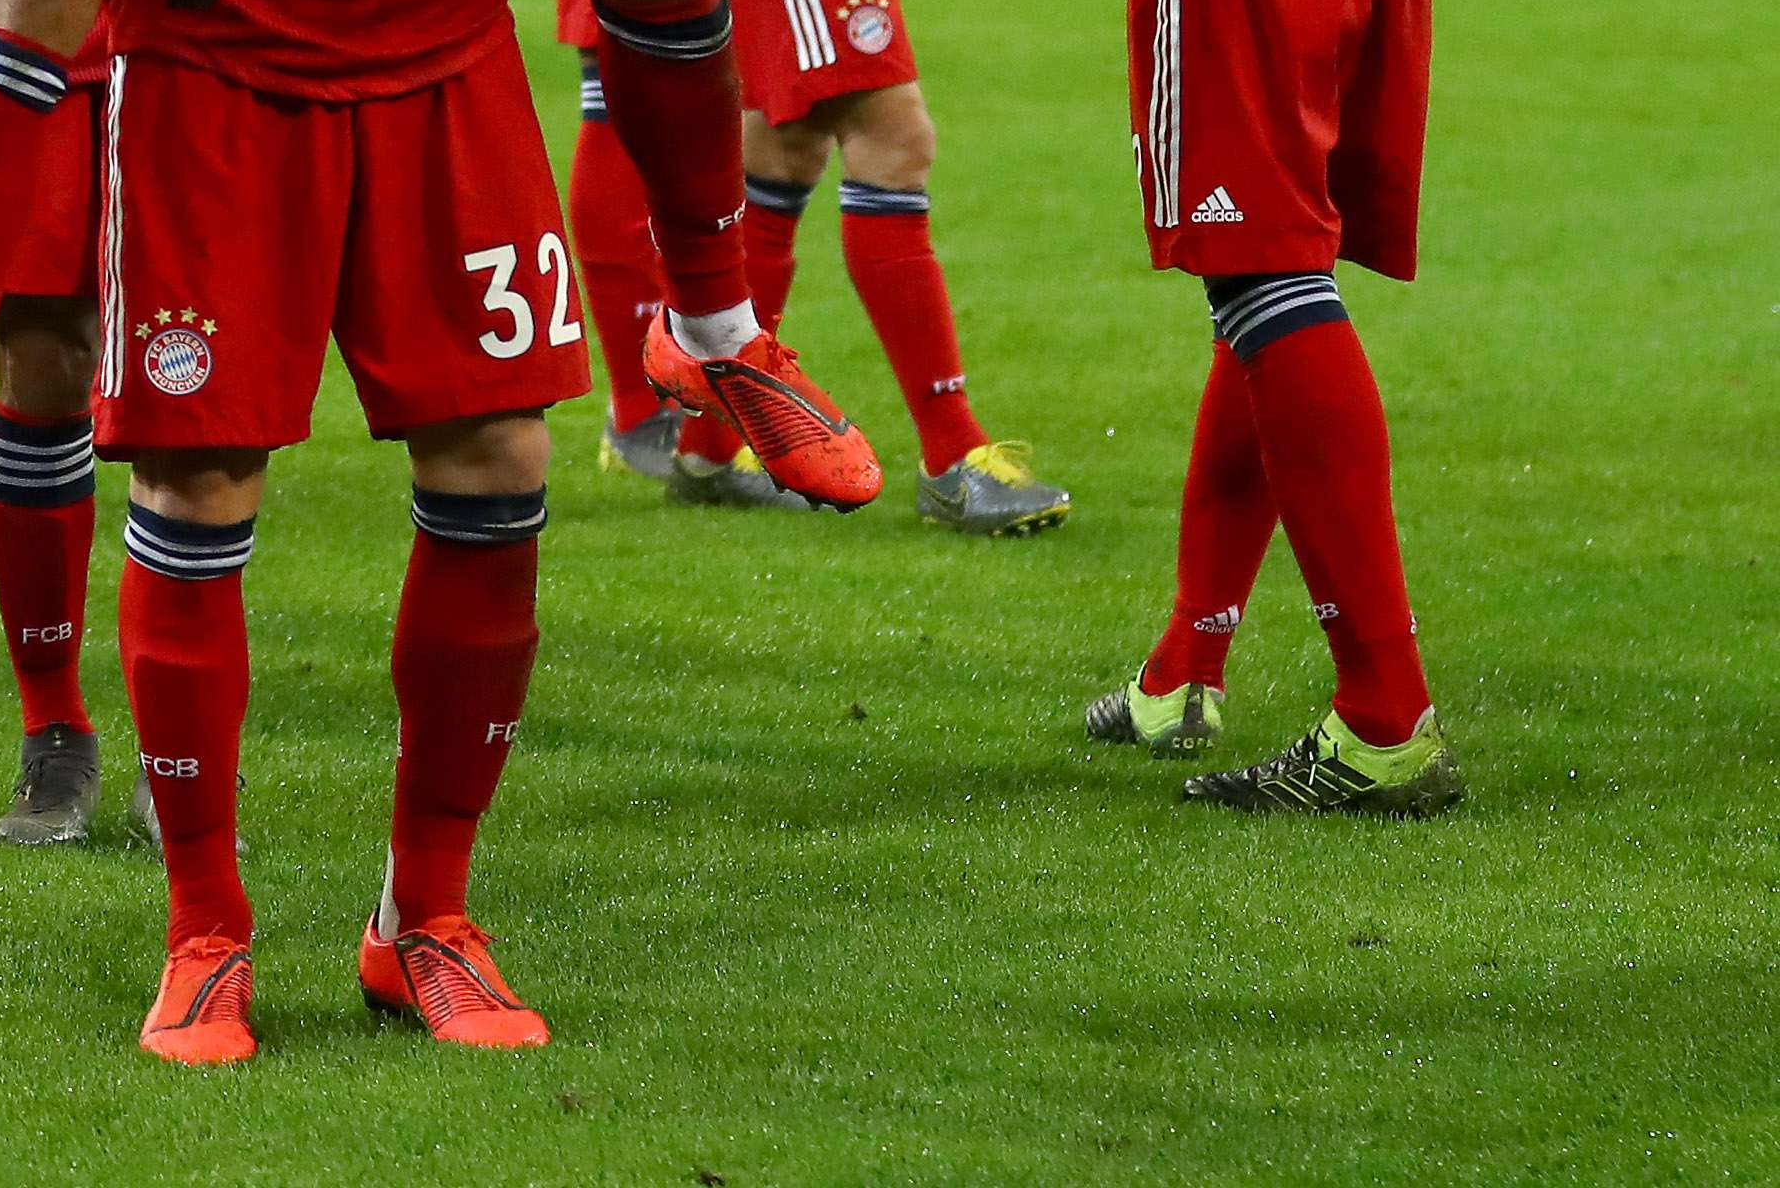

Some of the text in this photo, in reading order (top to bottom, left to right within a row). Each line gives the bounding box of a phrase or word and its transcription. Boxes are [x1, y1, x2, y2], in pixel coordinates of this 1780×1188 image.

[1191, 209, 1244, 223] adidas
[463, 231, 582, 359] 32
[1311, 603, 1339, 620] CB
[22, 622, 73, 644] FCB
[140, 751, 199, 778] FCB
